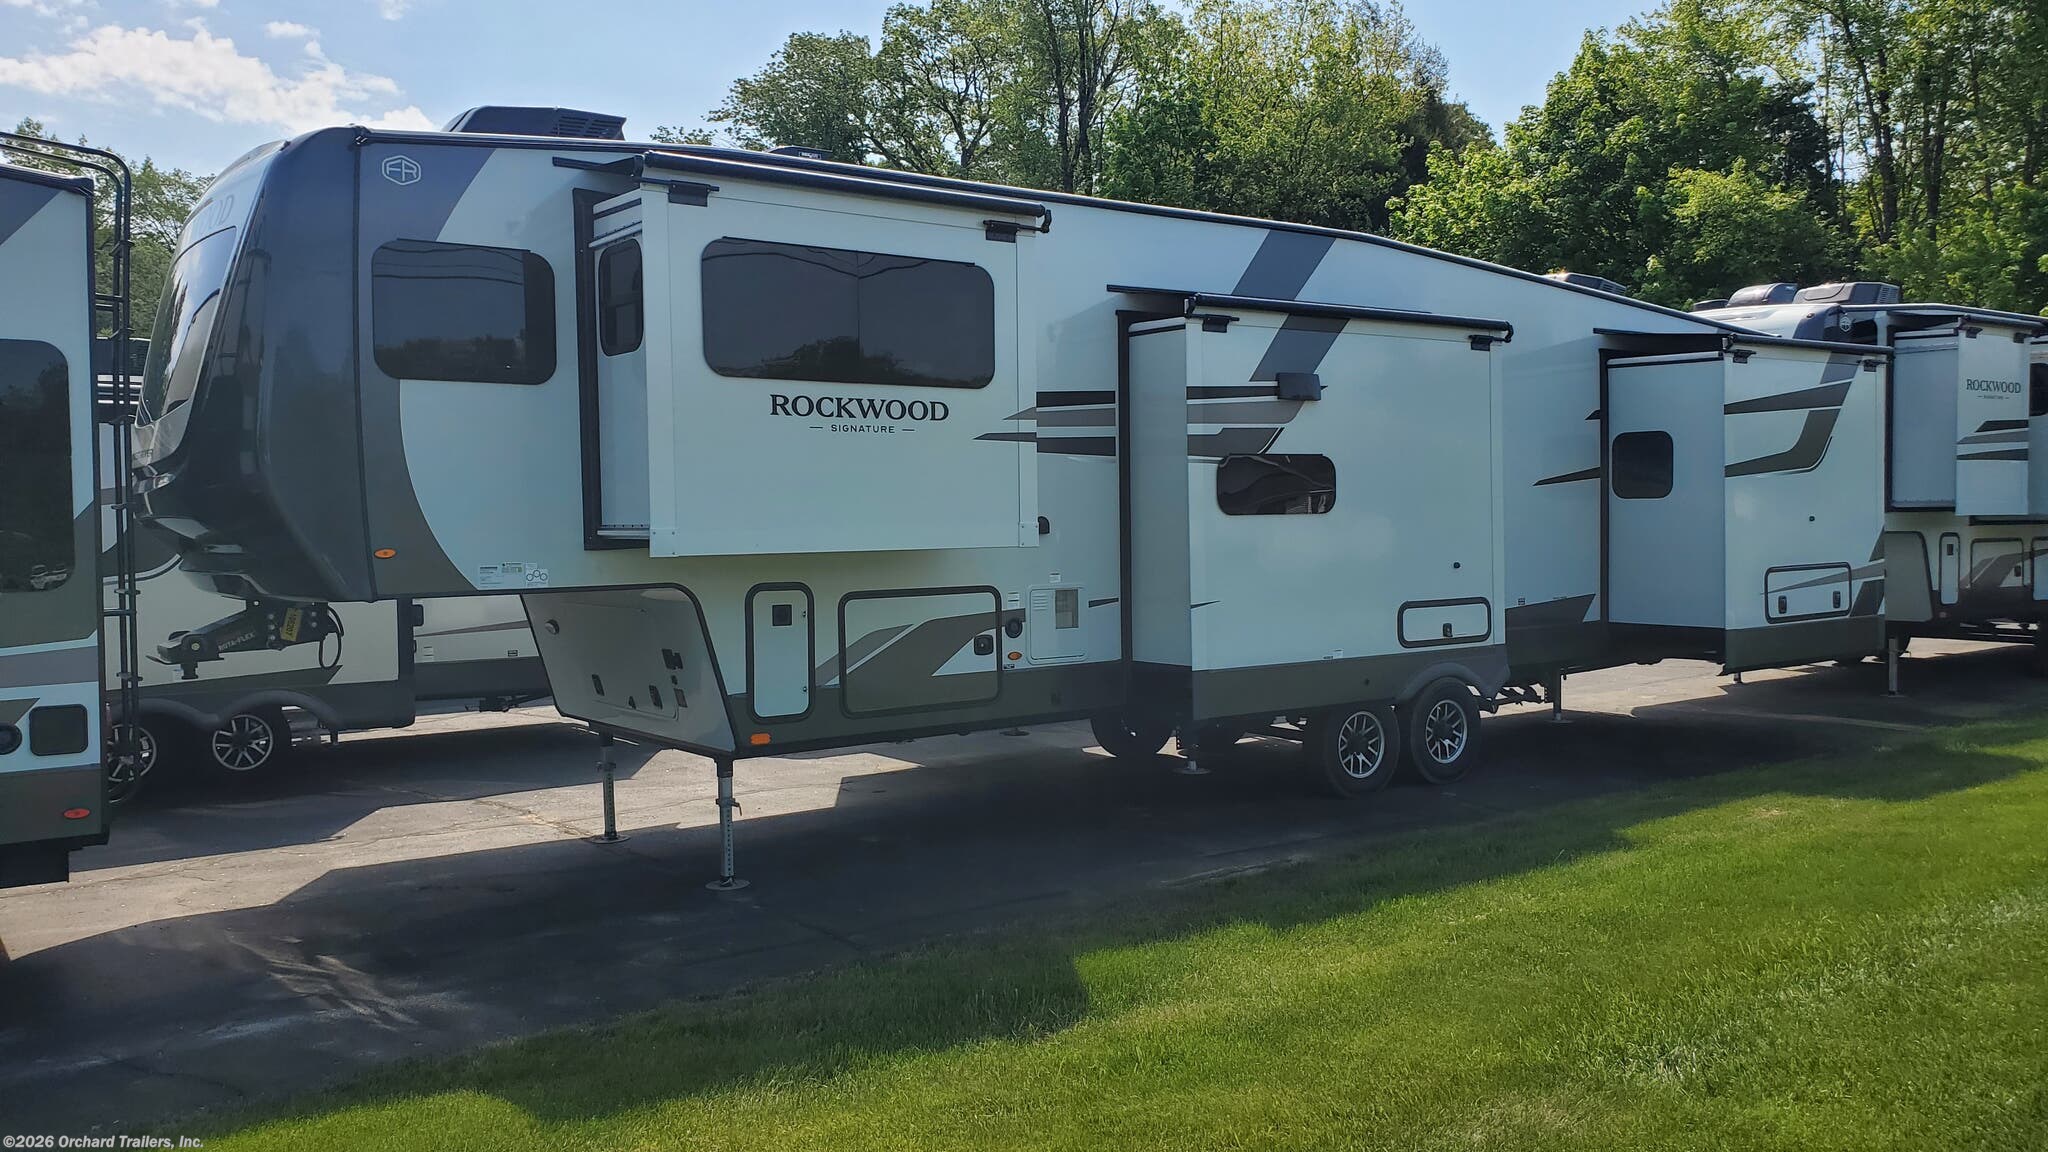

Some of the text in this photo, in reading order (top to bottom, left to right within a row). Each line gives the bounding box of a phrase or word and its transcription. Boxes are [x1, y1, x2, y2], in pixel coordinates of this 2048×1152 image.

[1966, 379, 2021, 393] ROCKWOOD
[769, 394, 949, 421] ROCKWOOD
[831, 424, 895, 433] SIGNATURE
